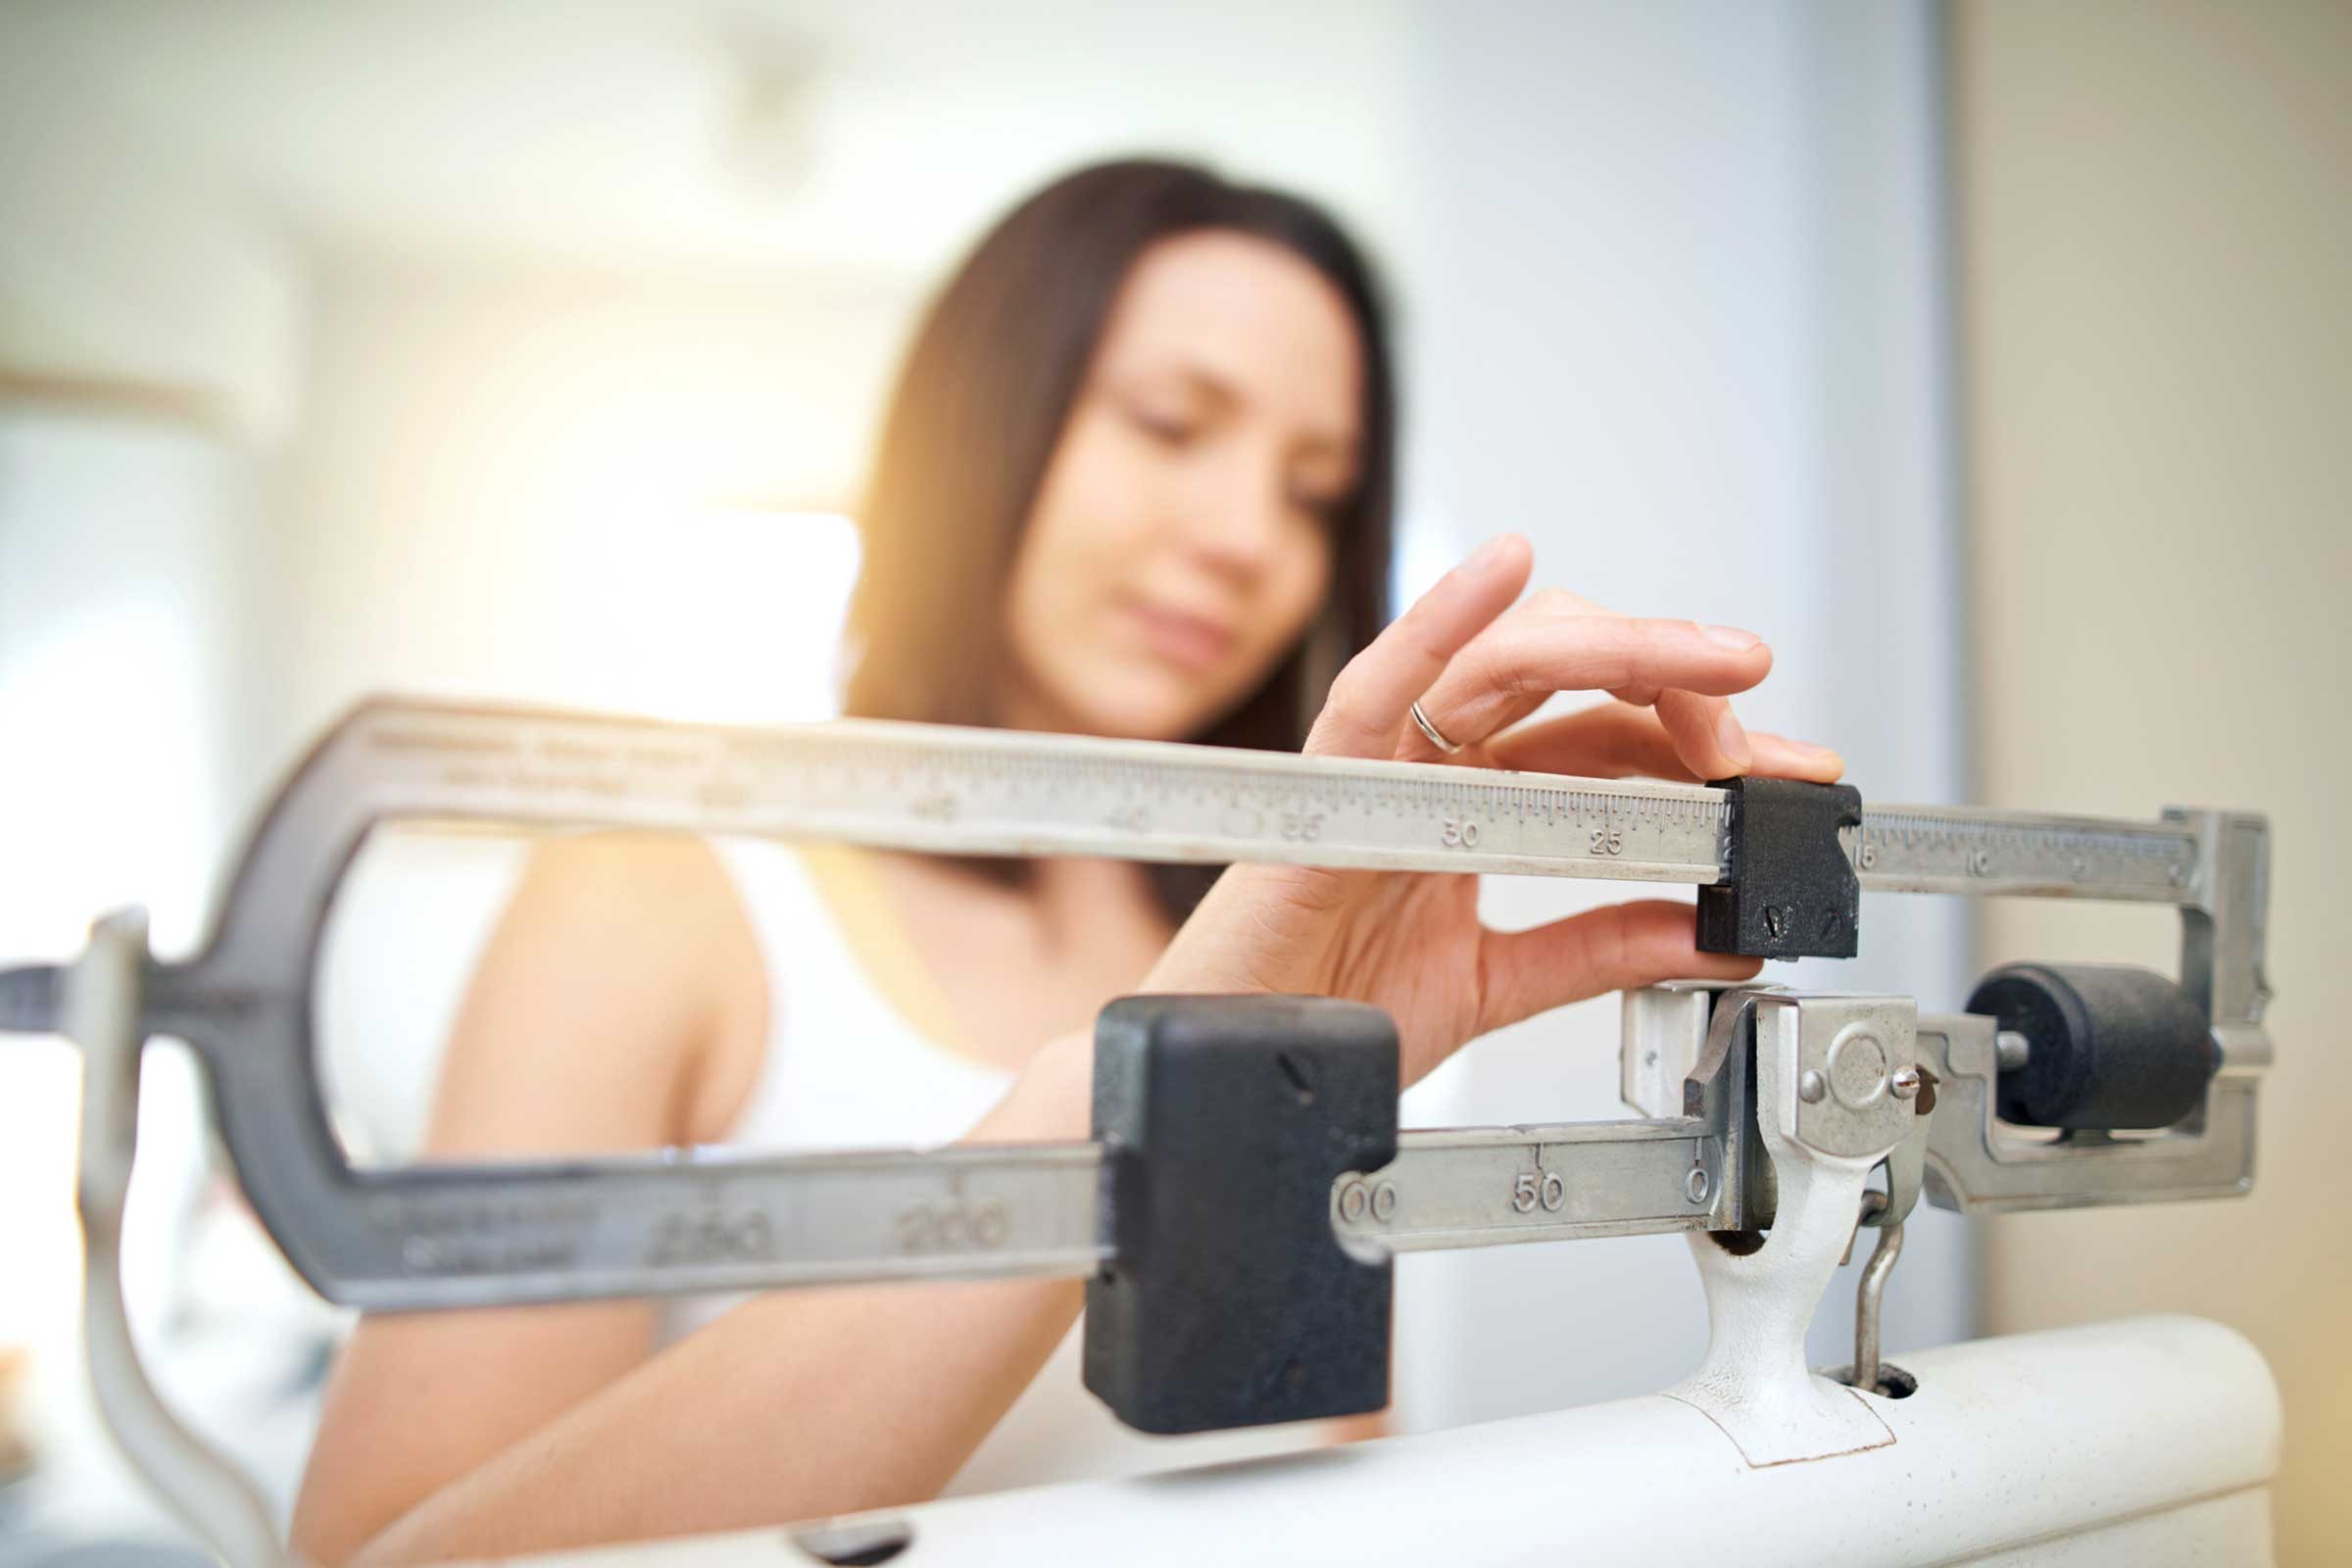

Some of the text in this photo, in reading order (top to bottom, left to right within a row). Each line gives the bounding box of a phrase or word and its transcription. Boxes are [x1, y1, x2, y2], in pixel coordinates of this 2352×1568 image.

[1443, 816, 1477, 849] 30
[1591, 828, 1623, 856] 25
[1854, 844, 1877, 870] 15
[1966, 849, 1991, 878] 10
[896, 1198, 1011, 1250] 200
[1339, 1181, 1396, 1224] 00
[1512, 1172, 1565, 1214] 50
[1685, 1164, 1710, 1205] 0
